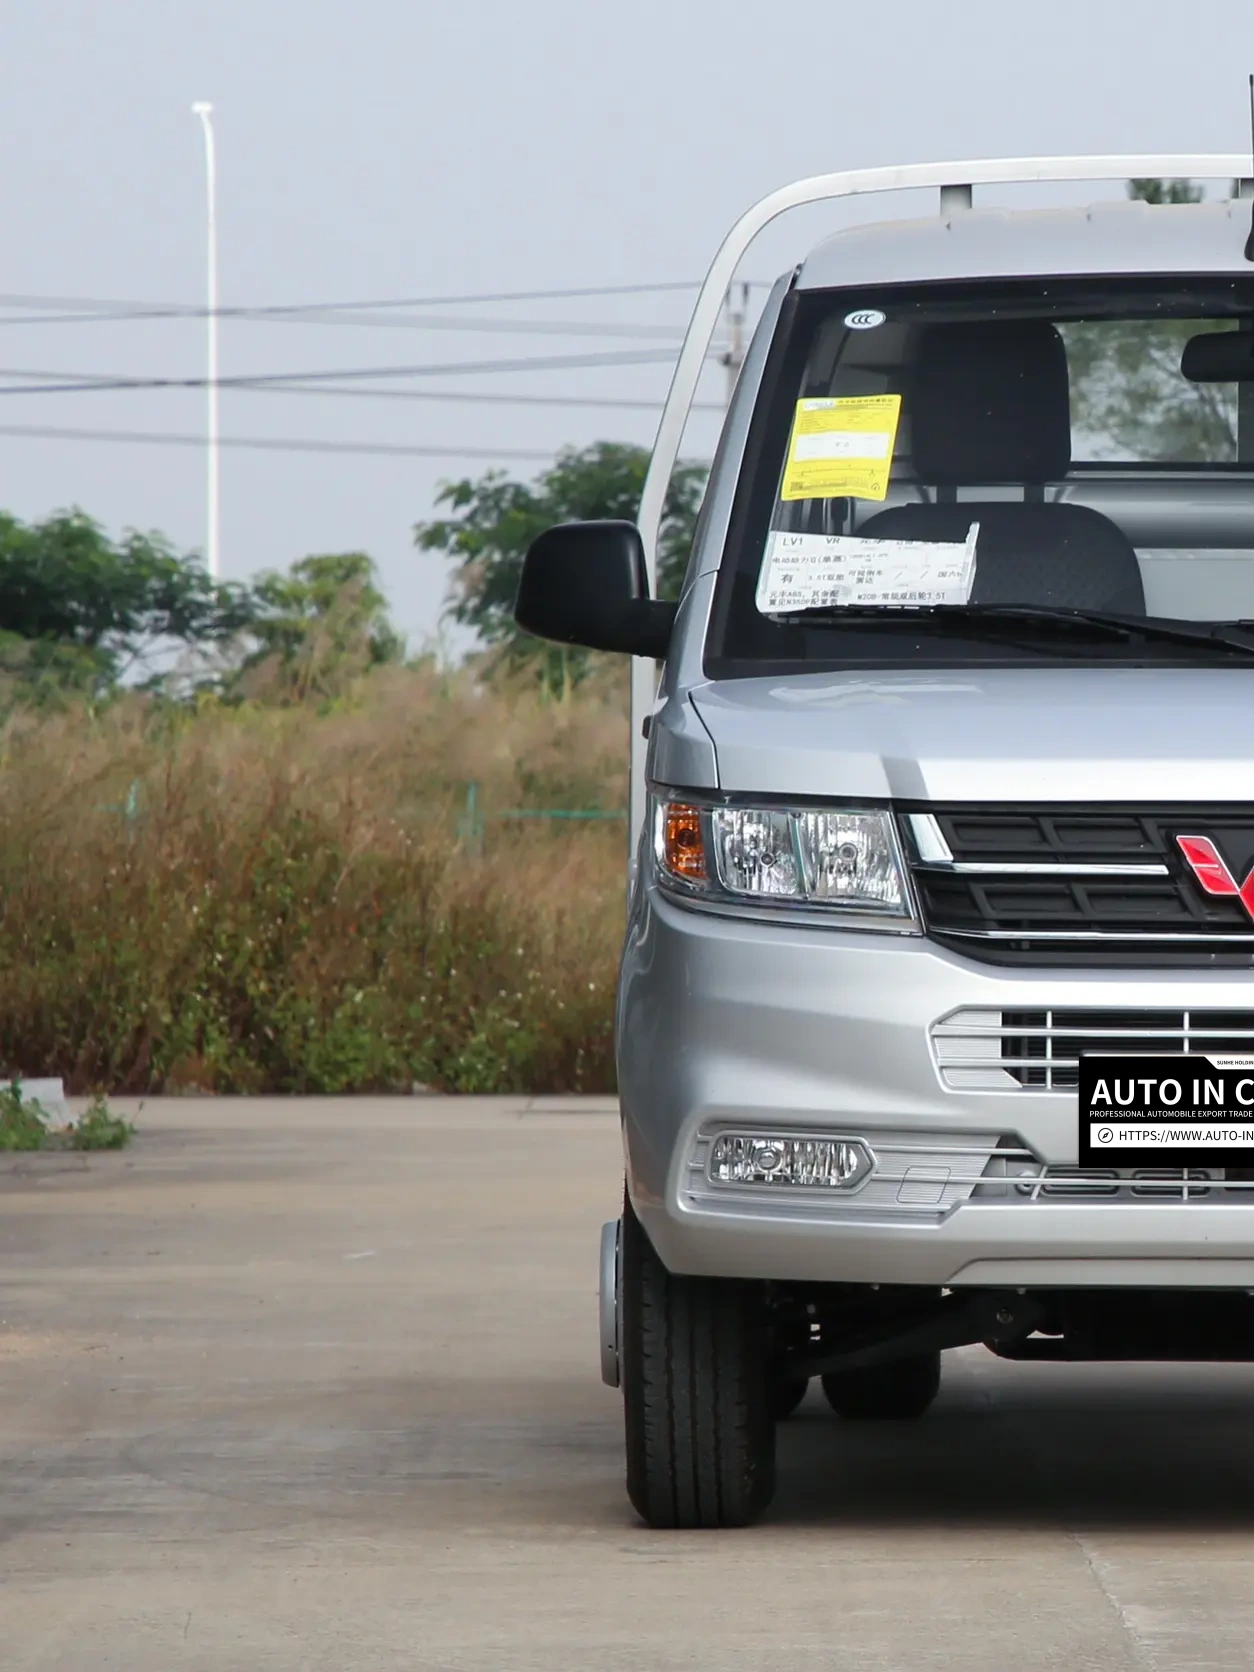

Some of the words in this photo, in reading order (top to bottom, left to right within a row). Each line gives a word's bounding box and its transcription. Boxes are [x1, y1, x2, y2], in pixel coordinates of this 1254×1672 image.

[782, 537, 804, 546] LV1
[826, 537, 841, 545] VR
[780, 574, 794, 584] 有
